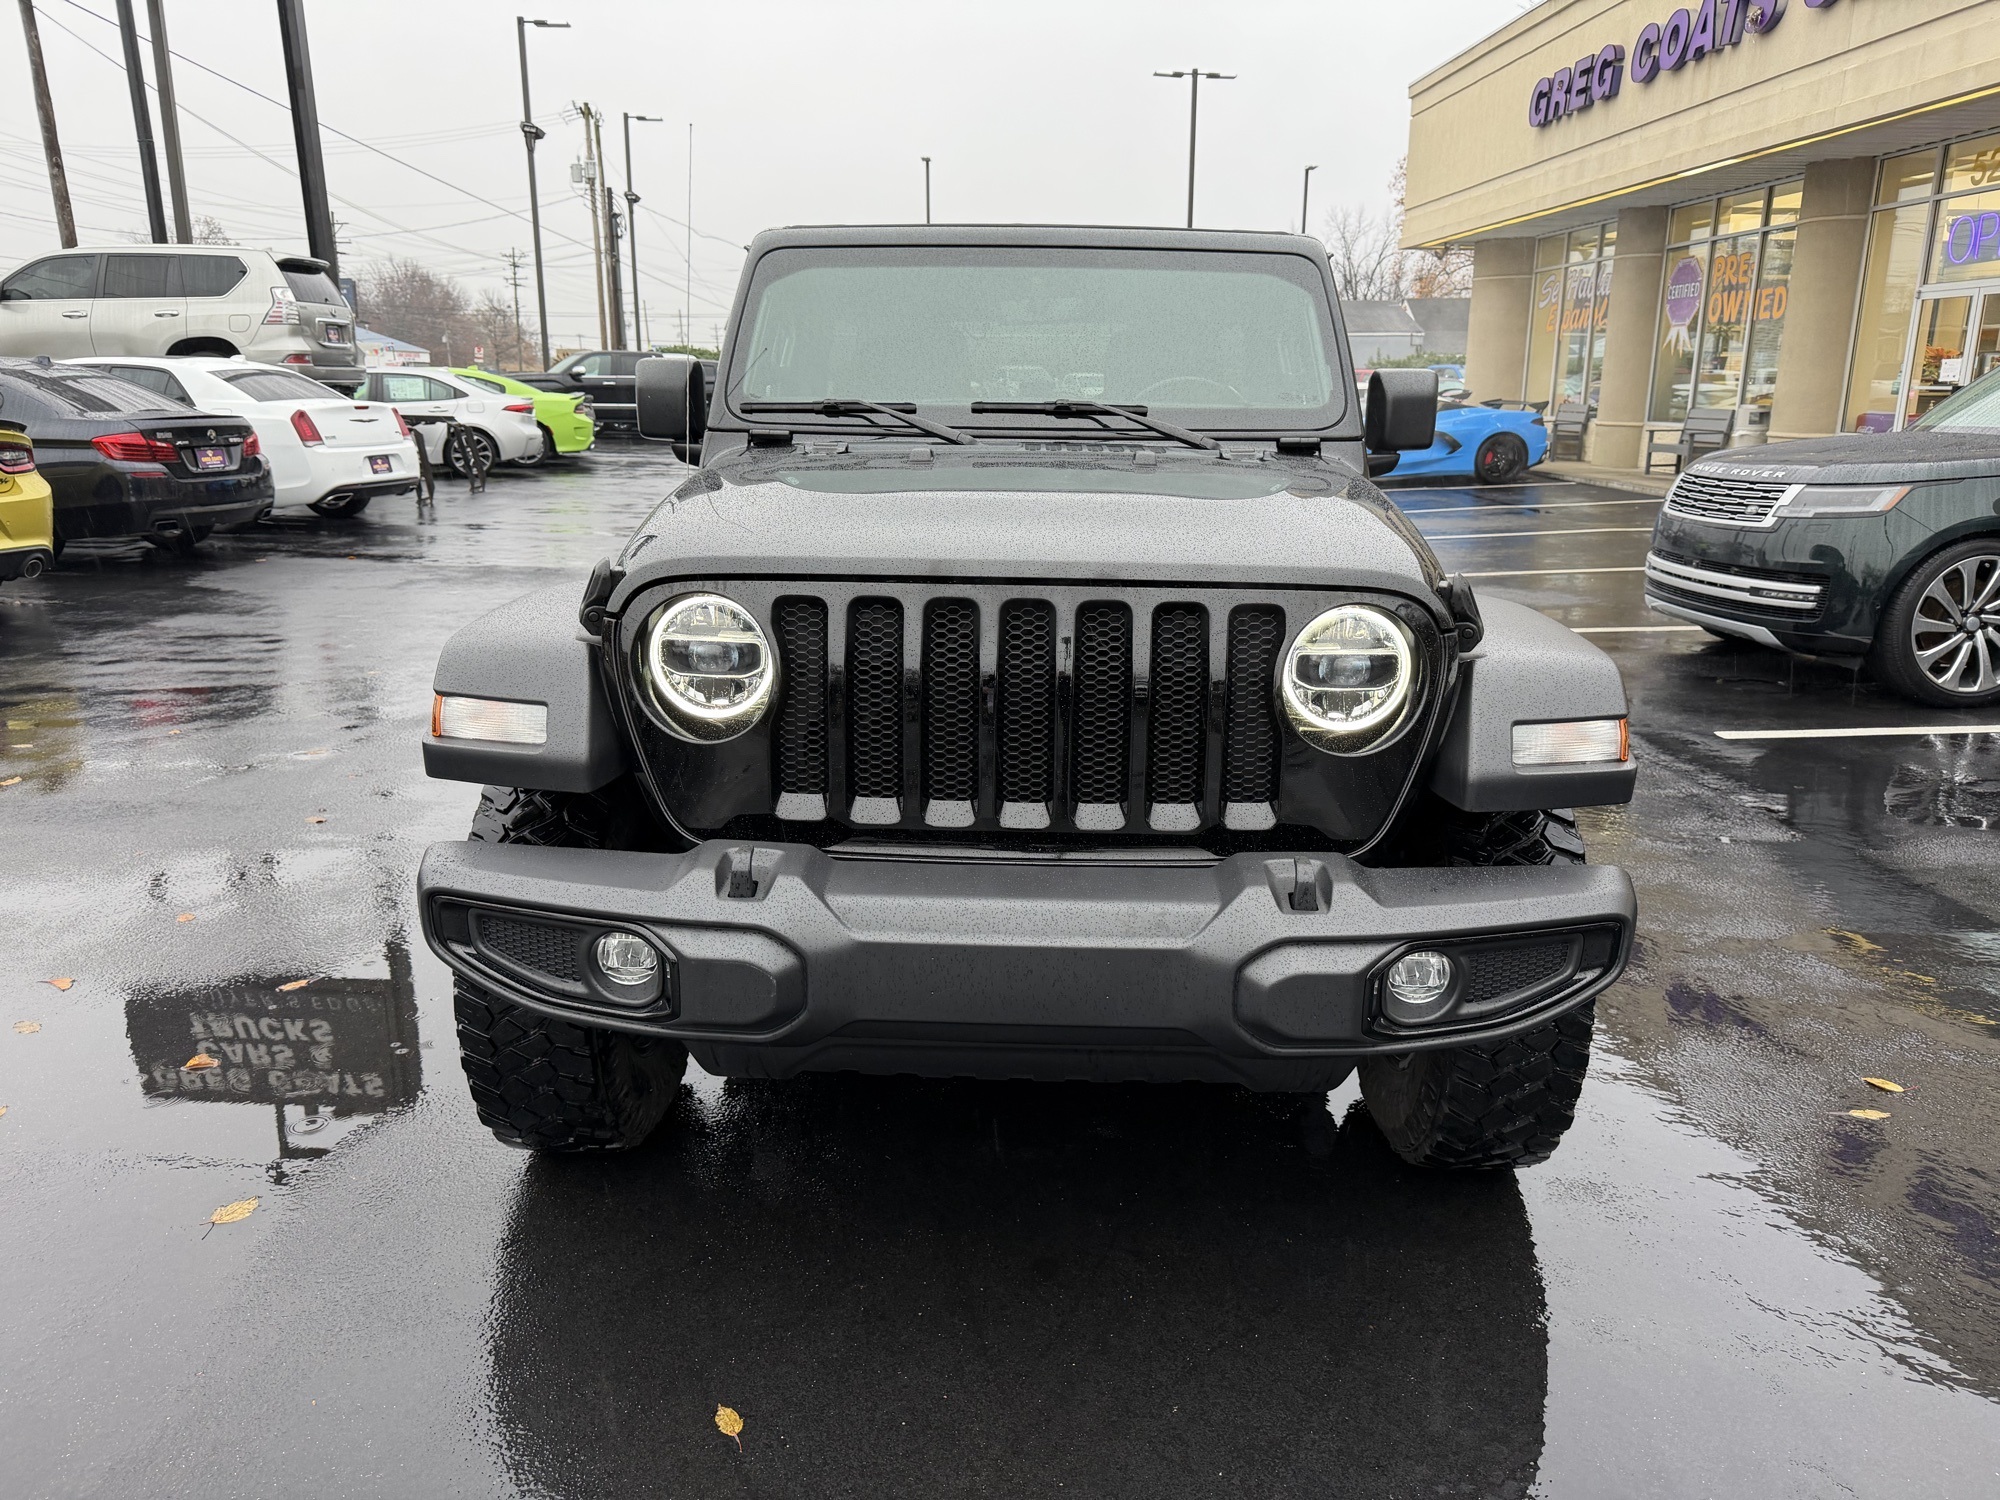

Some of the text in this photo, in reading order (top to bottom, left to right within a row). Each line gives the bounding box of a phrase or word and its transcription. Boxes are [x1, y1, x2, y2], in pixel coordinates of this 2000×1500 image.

[1529, 0, 1788, 128] GREG COATS
[1949, 212, 2000, 264] OP
[1538, 274, 1560, 309] Se
[1667, 282, 1700, 300] CERTIFIED
[1708, 286, 1788, 323] OWNED
[1691, 463, 1786, 478] RANGE ROVER
